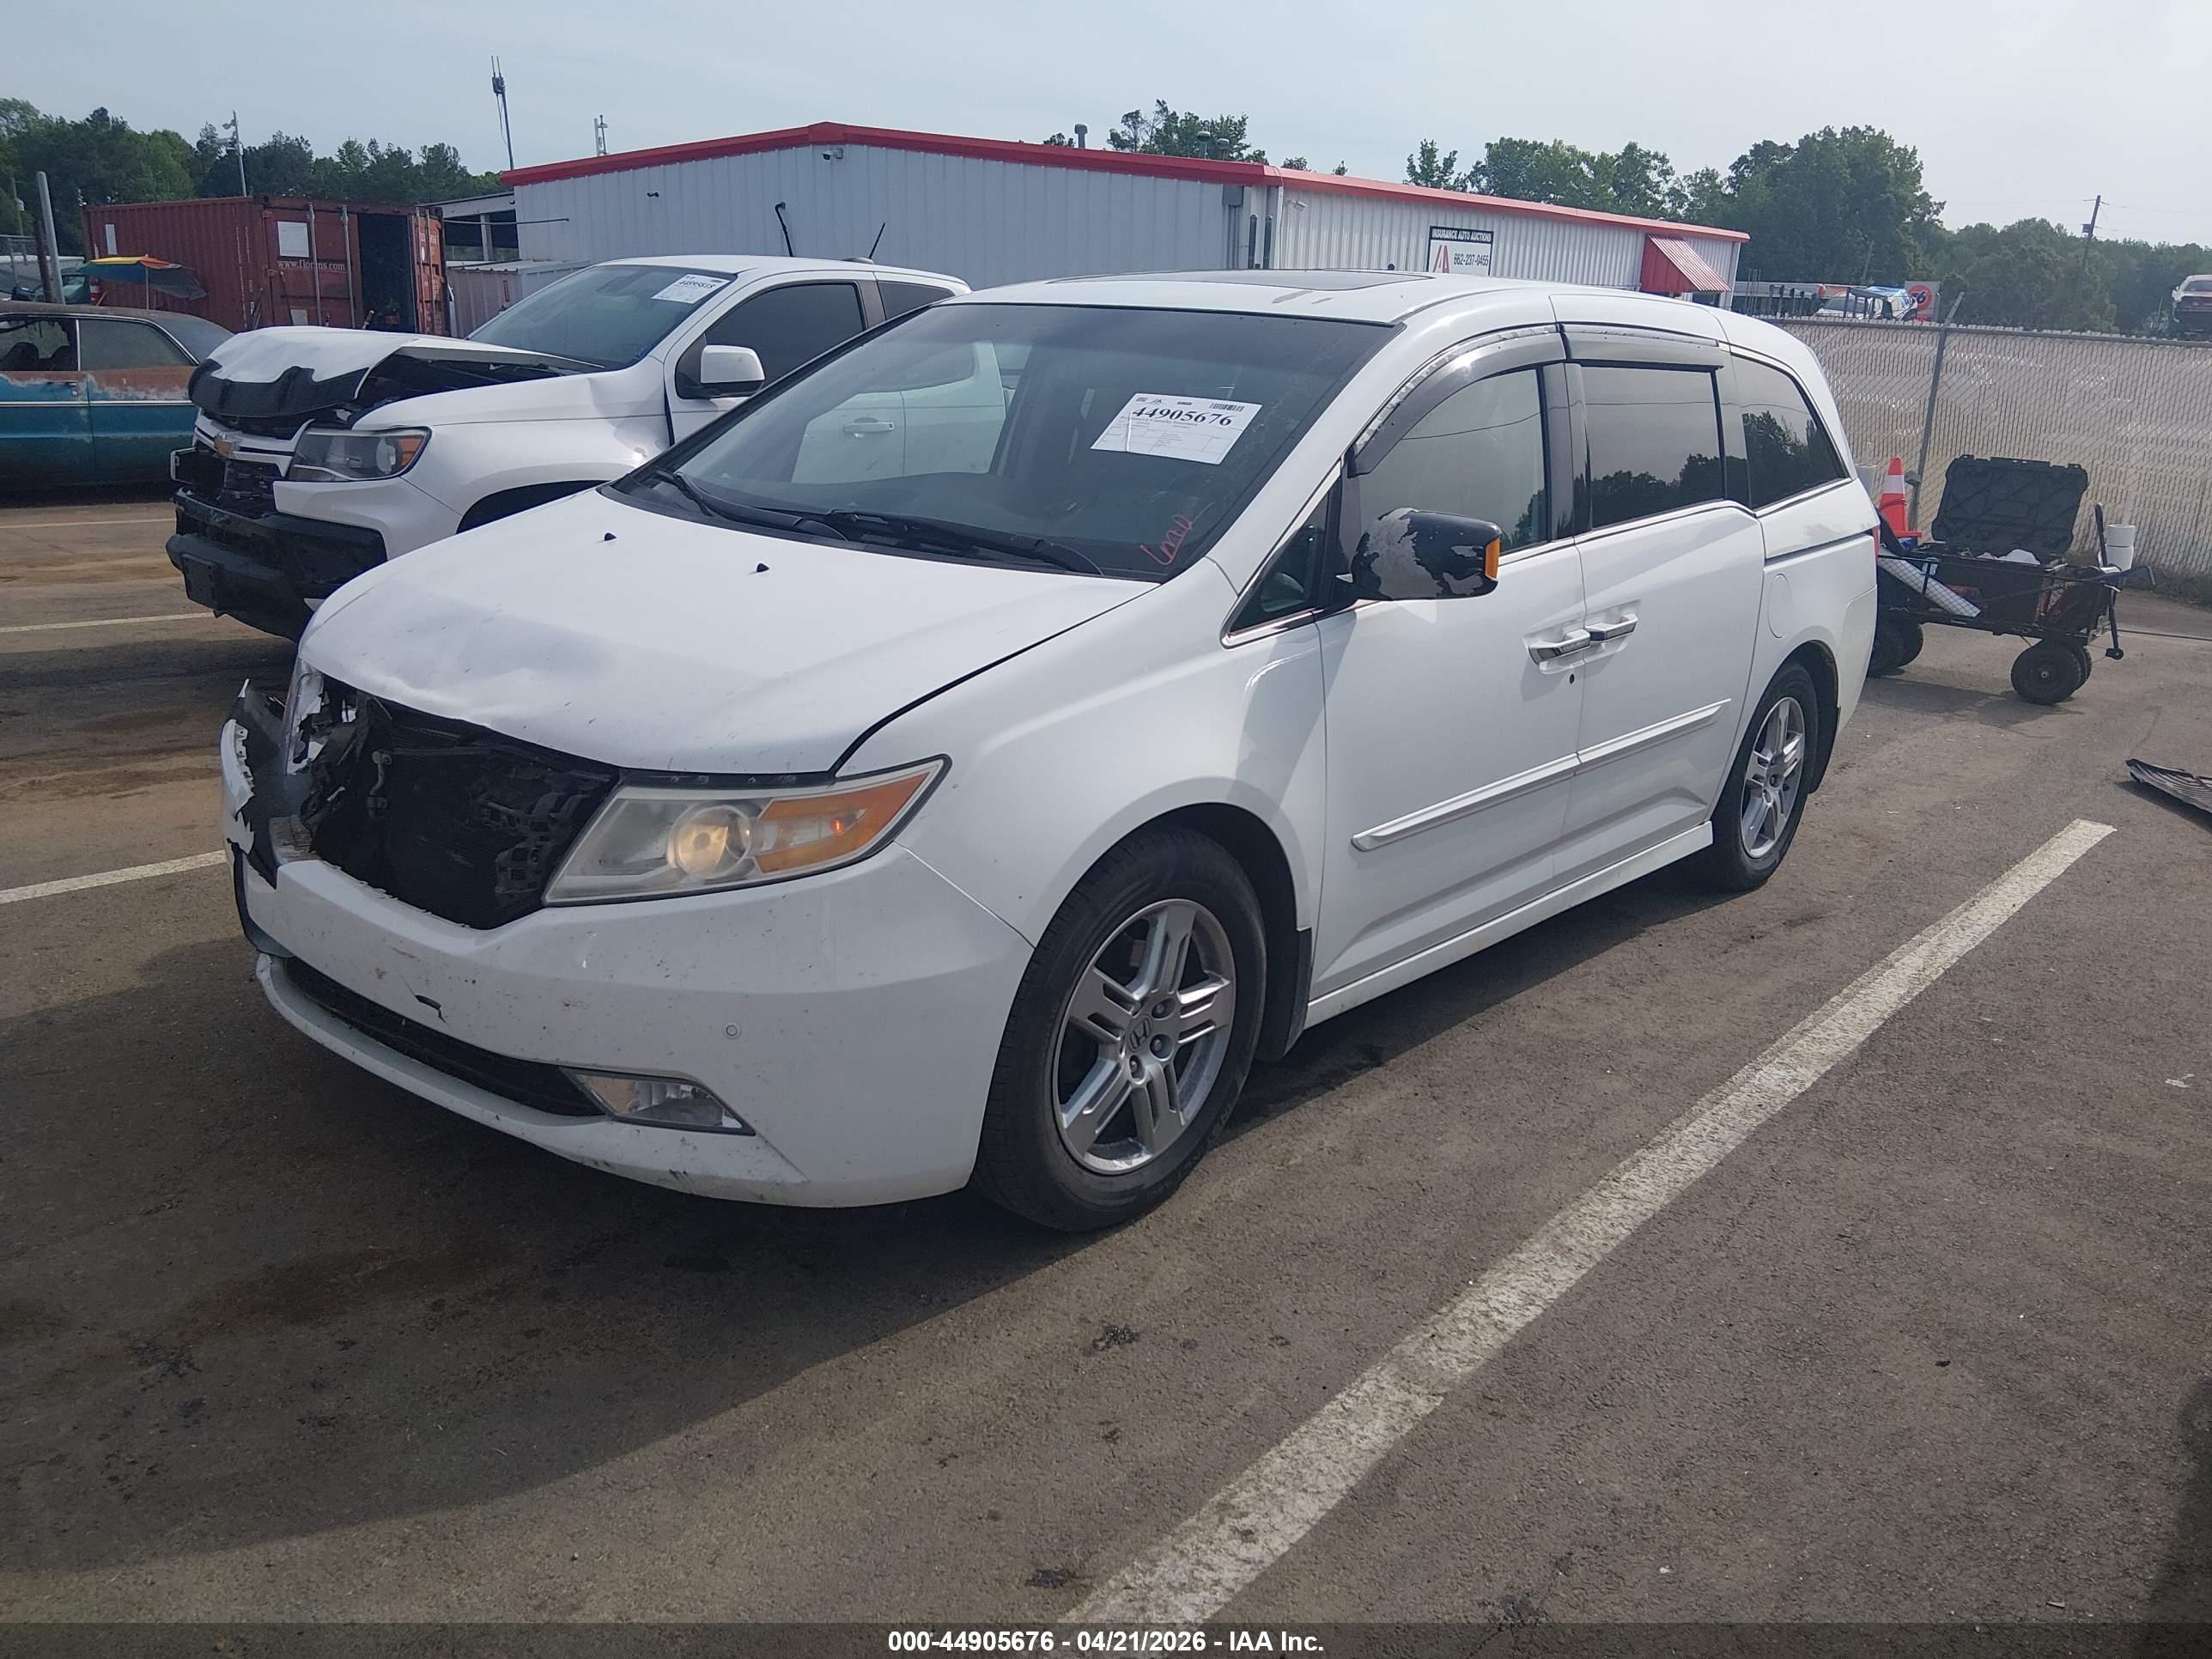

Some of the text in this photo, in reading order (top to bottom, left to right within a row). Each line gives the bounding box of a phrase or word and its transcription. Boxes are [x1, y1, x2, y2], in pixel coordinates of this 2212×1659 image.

[1431, 228, 1492, 242] INSURANCE AUTO AUCTIONS
[1132, 406, 1237, 427] 44905676
